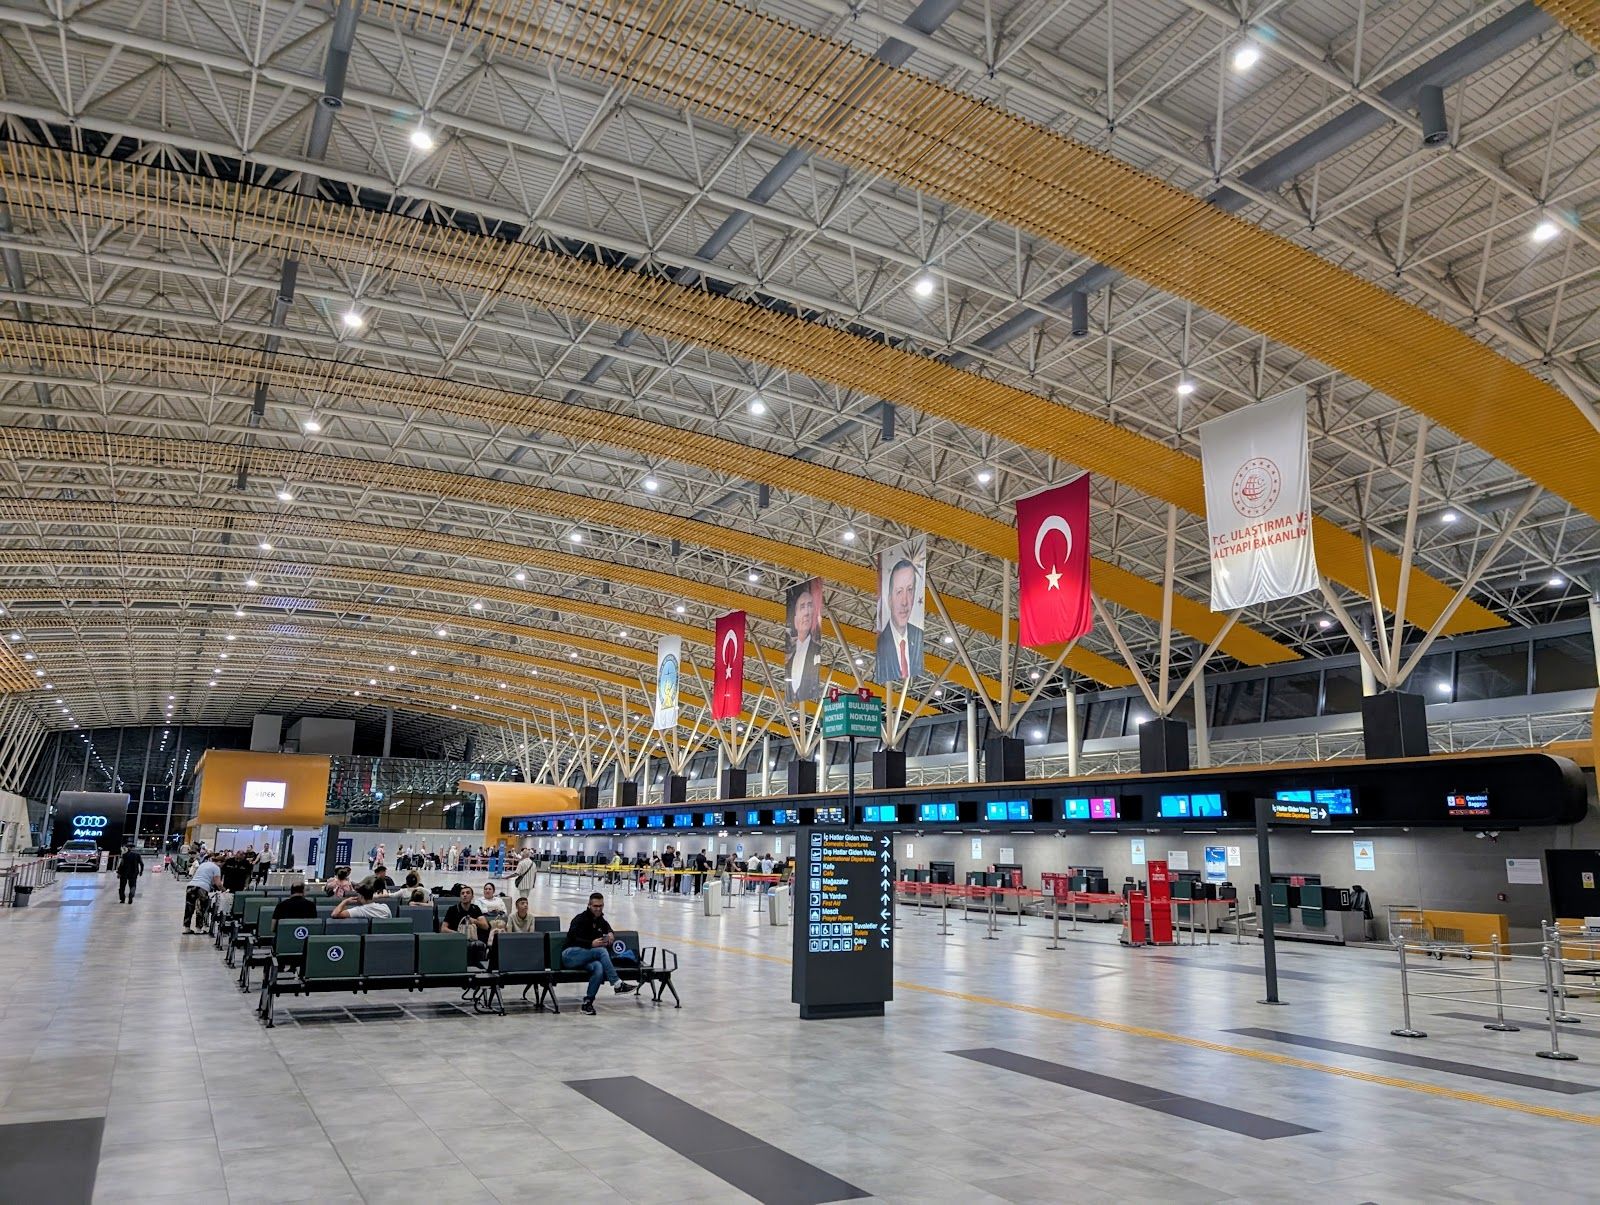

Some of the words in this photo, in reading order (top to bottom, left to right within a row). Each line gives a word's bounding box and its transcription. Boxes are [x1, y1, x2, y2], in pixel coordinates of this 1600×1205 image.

[1212, 534, 1228, 546] T.C.
[1231, 516, 1292, 541] ULAŞTIRMA
[1214, 541, 1252, 559] ALTYAPI
[848, 702, 879, 712] BULUŞMA
[850, 713, 878, 722] NOKTASI
[74, 829, 102, 837] Aykan
[823, 848, 832, 856] Dış
[823, 878, 849, 886] Mağazalar
